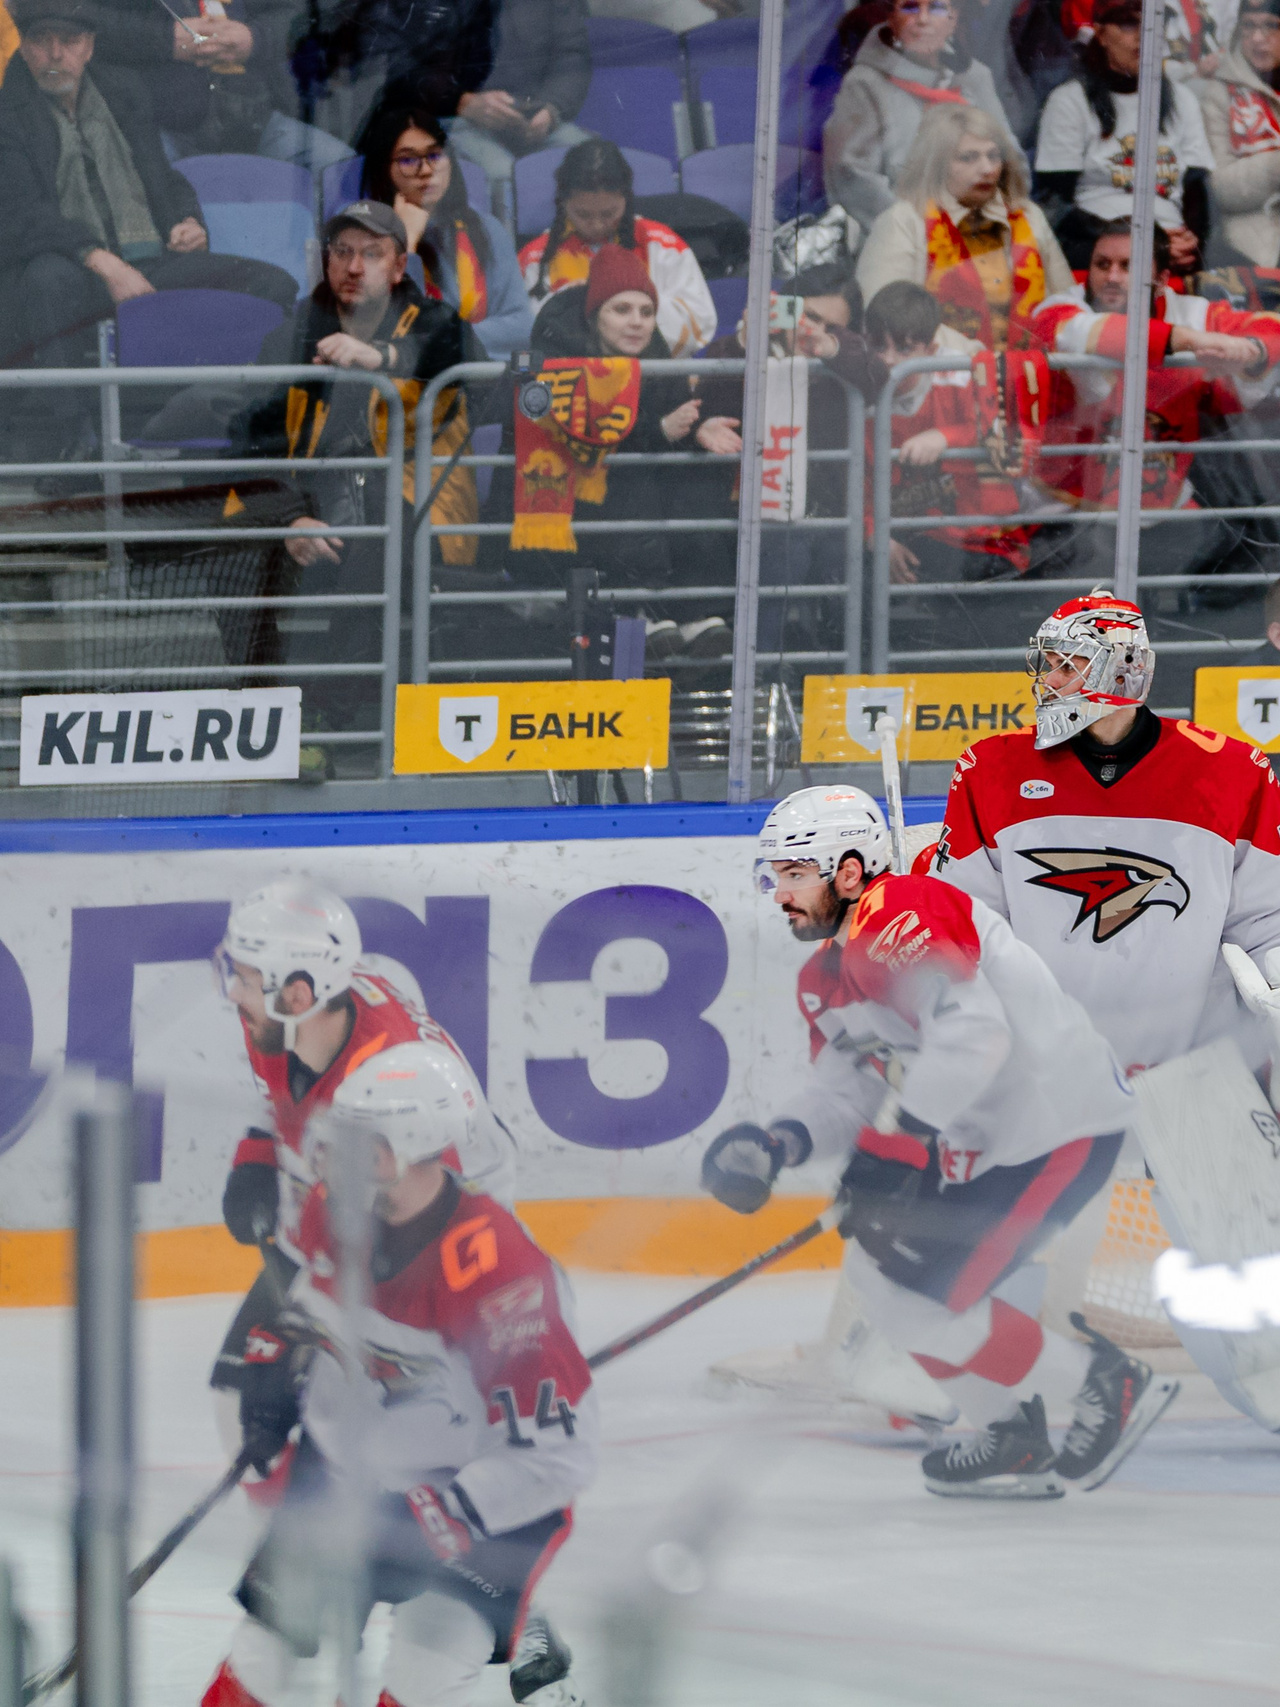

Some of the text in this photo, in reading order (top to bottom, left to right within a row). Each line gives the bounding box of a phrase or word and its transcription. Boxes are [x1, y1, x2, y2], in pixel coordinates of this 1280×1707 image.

[510, 712, 623, 740] БАНК
[915, 703, 1026, 731] БАНК
[38, 707, 283, 766] KHL.RU
[840, 829, 867, 837] CCM
[491, 1377, 577, 1449] 14
